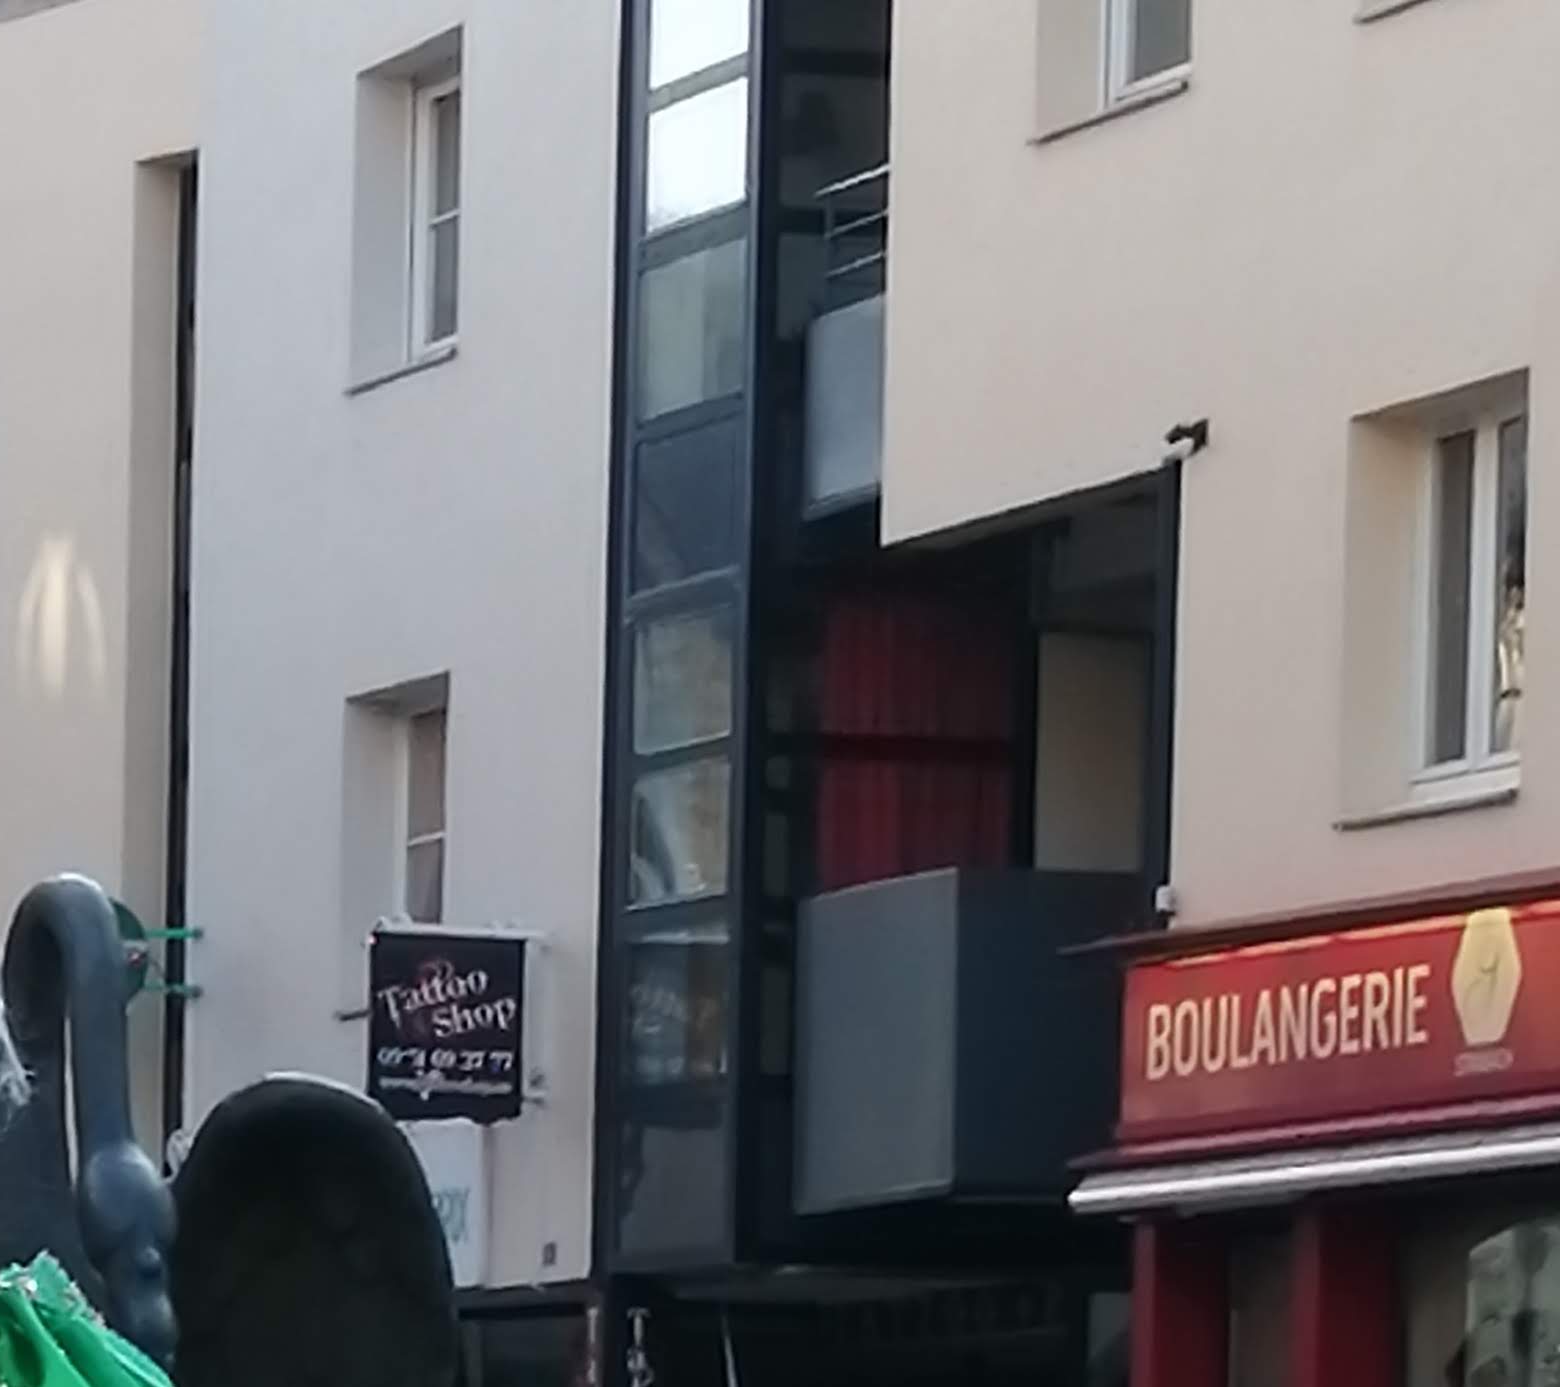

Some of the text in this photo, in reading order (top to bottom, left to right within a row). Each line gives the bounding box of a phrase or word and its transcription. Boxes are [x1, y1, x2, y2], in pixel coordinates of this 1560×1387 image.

[377, 969, 489, 1029] Tattoo
[431, 997, 517, 1038] Shop
[1145, 964, 1431, 1081] BOULANGERIE
